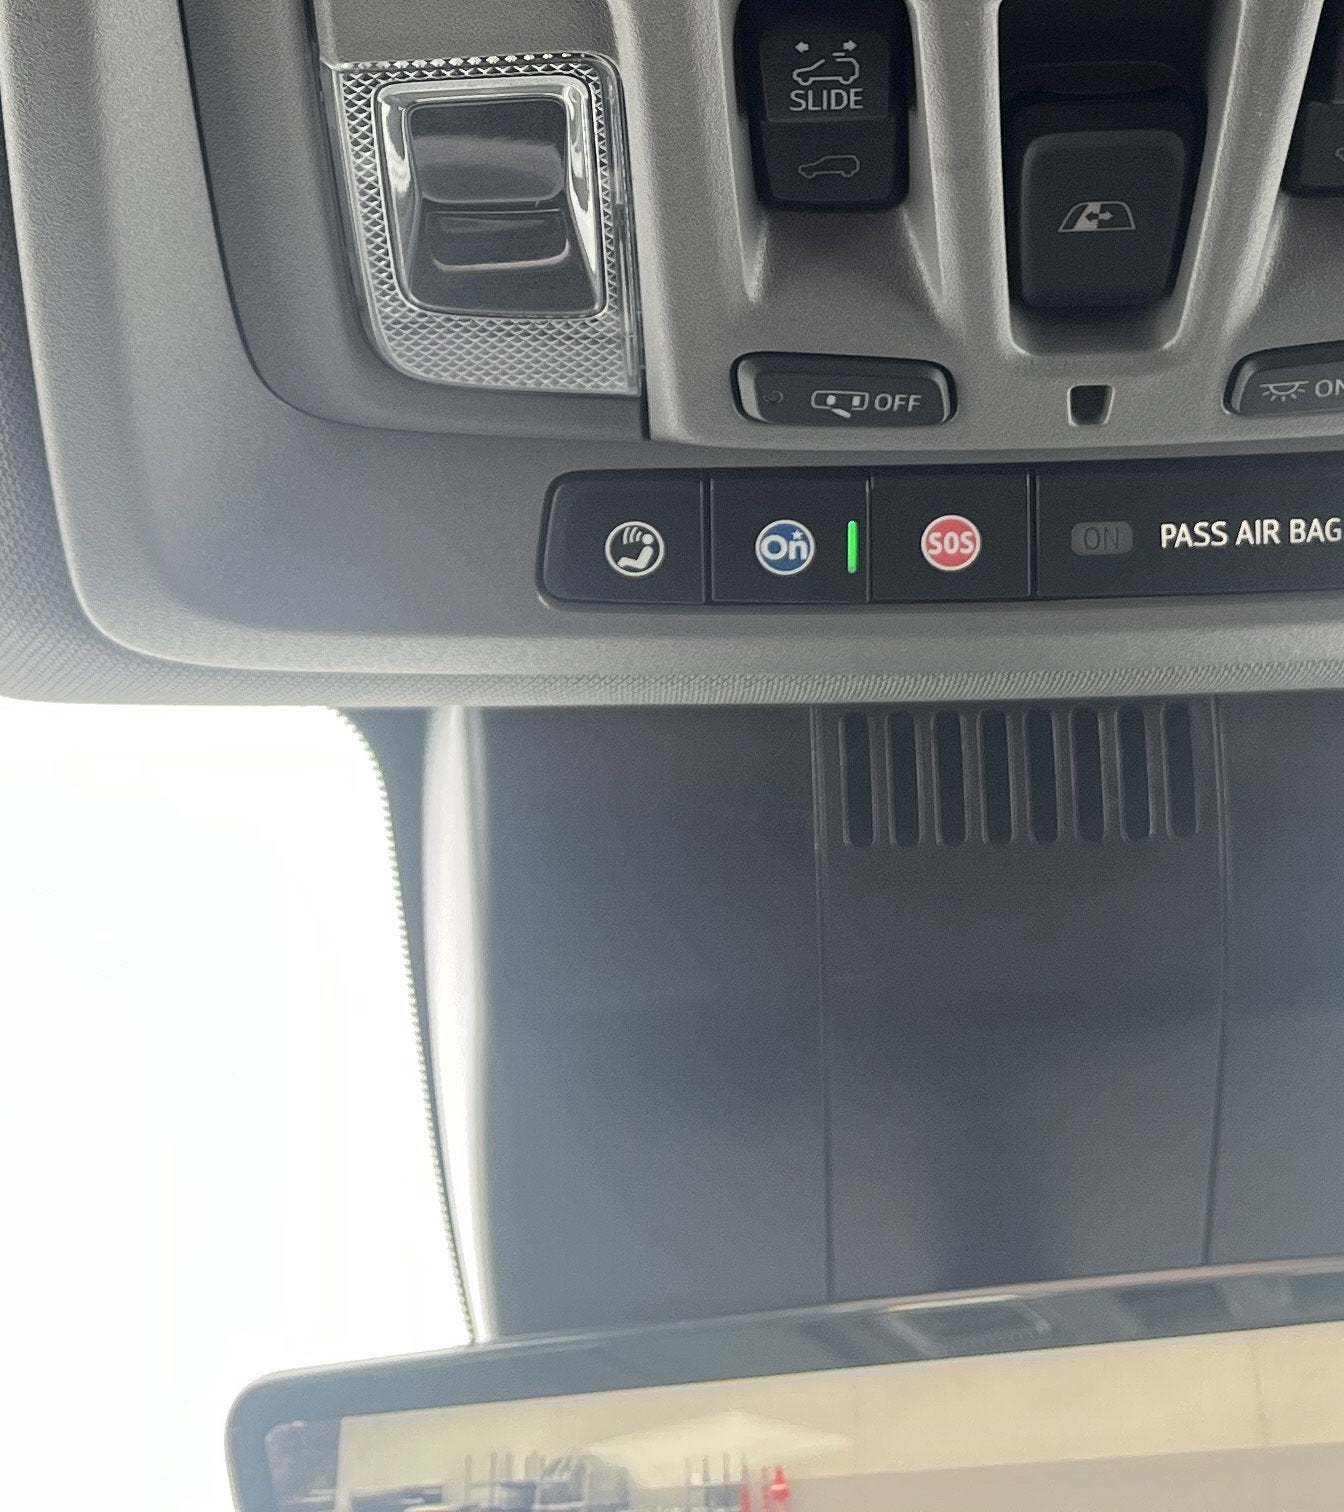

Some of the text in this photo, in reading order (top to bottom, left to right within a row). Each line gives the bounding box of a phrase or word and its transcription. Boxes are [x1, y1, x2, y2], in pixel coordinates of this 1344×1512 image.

[789, 88, 864, 111] SLIDE
[874, 393, 922, 412] OFF
[928, 531, 975, 555] SOS
[1084, 525, 1119, 550] ON
[1160, 520, 1228, 549] PASS
[1235, 519, 1281, 546] AIR
[1289, 517, 1342, 543] BAG
[760, 534, 808, 562] On
